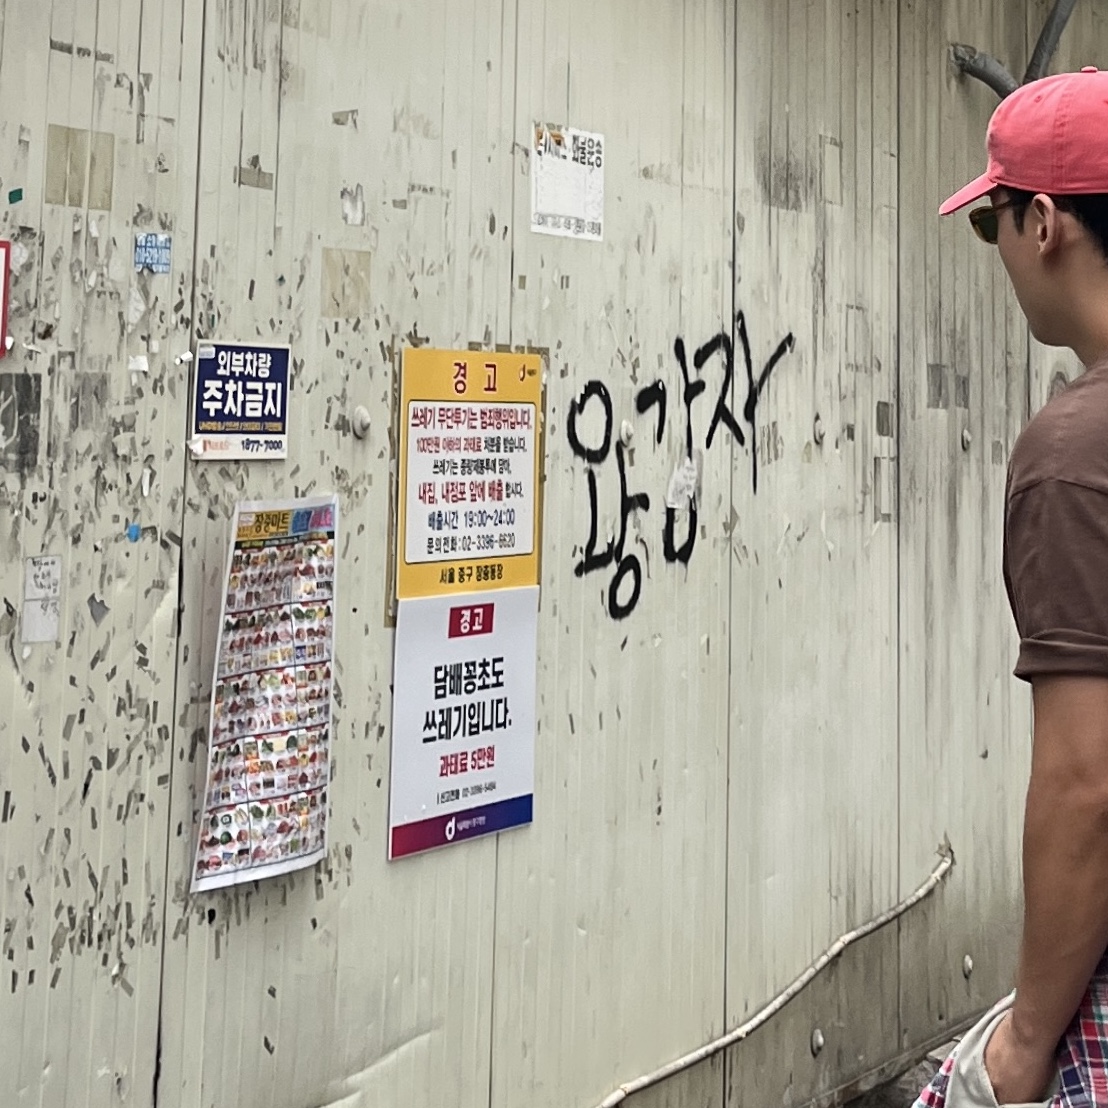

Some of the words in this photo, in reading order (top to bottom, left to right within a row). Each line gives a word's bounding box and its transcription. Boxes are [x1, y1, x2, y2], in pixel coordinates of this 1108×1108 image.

[216, 350, 272, 378] 외부차량
[202, 379, 282, 418] 주차금지
[411, 406, 435, 430] 쓰레기
[438, 407, 477, 430] 무단투기는
[241, 438, 283, 452] 1877-7000
[432, 459, 458, 475] 쓰레기는
[469, 480, 485, 502] 앞에
[488, 479, 503, 502] 배출
[428, 509, 458, 531] 배출시간
[464, 507, 515, 528] 19:00~24:00
[440, 566, 455, 583] 서울
[458, 565, 473, 582] 중구
[460, 608, 484, 633] 경고
[434, 656, 504, 700] 담배꽁초도
[422, 697, 512, 743] 쓰레기입니다.
[439, 751, 468, 777] 과태료
[471, 744, 495, 770] 5만원
